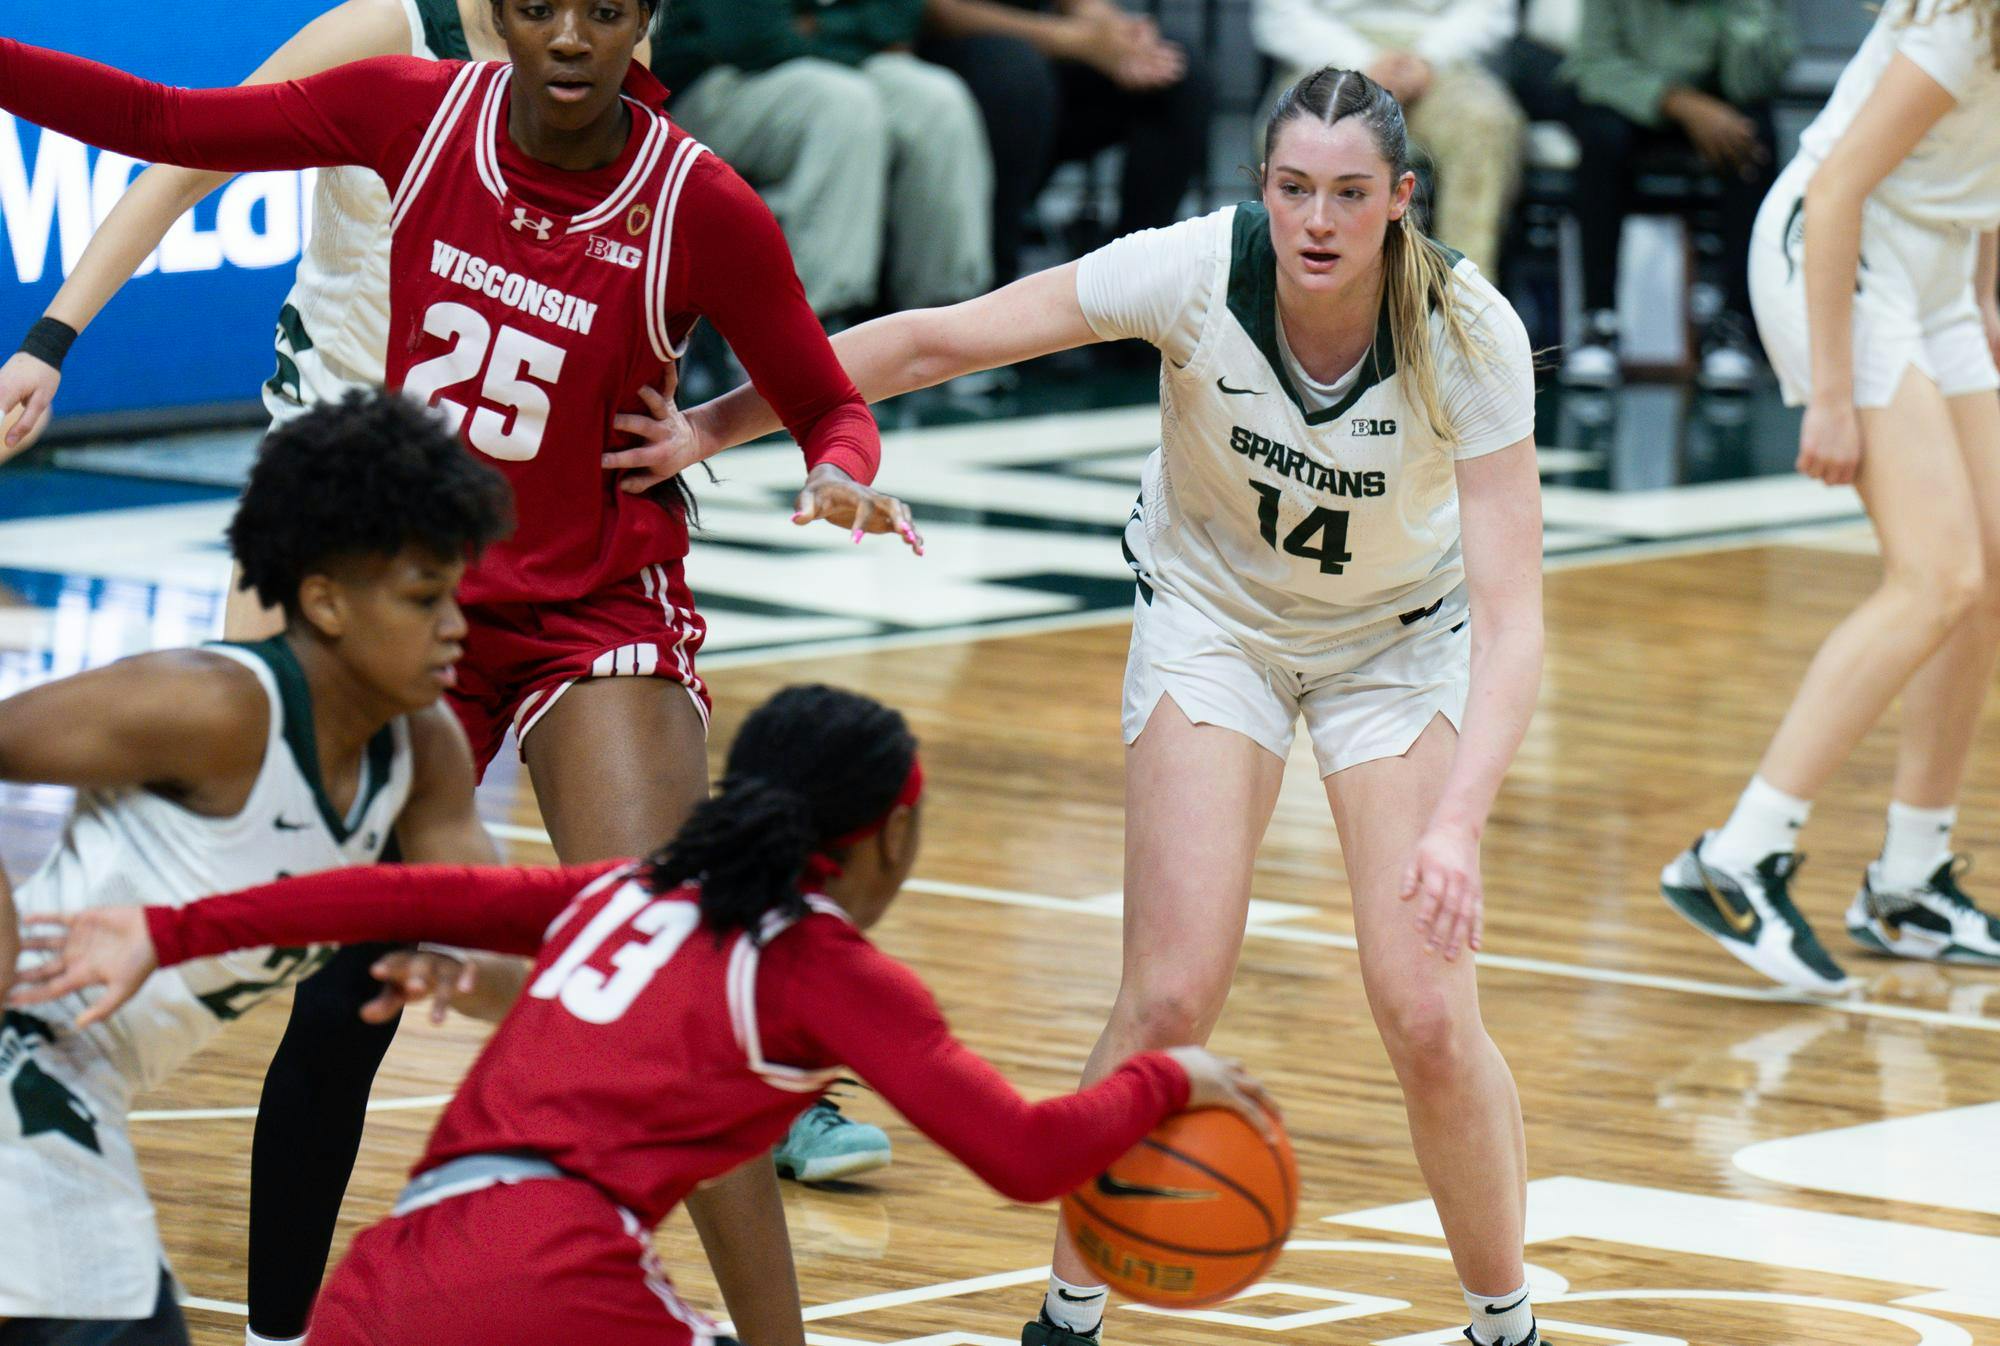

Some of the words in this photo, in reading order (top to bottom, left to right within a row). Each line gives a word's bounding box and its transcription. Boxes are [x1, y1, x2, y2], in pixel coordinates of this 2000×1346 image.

[430, 239, 598, 335] WISCONSIN
[402, 301, 567, 461] 25
[1230, 426, 1386, 498] SPARTANS
[1248, 478, 1352, 575] 14
[529, 879, 700, 1025] 13
